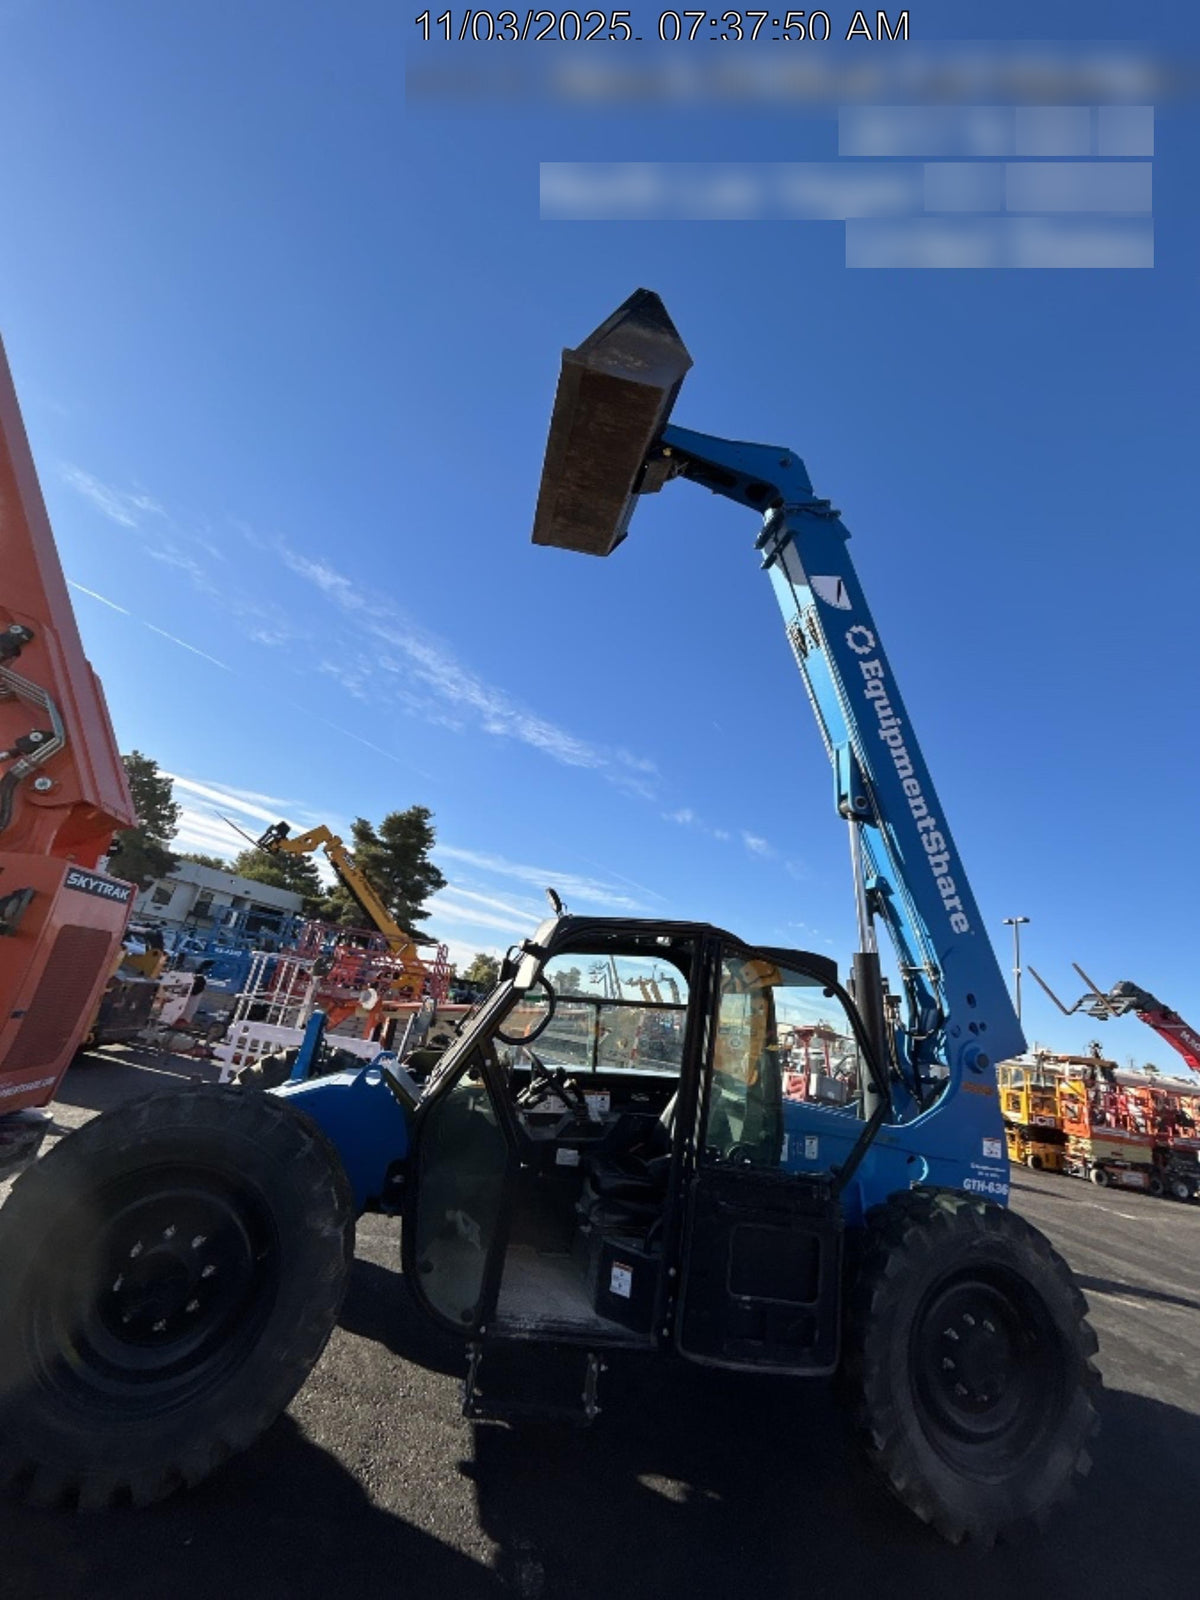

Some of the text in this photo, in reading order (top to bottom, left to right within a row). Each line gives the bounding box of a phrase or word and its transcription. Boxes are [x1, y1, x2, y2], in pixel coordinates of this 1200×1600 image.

[858, 659, 970, 935] EquipmentShare
[67, 872, 131, 900] SKYTRAK
[963, 1177, 1009, 1196] GTH-636
